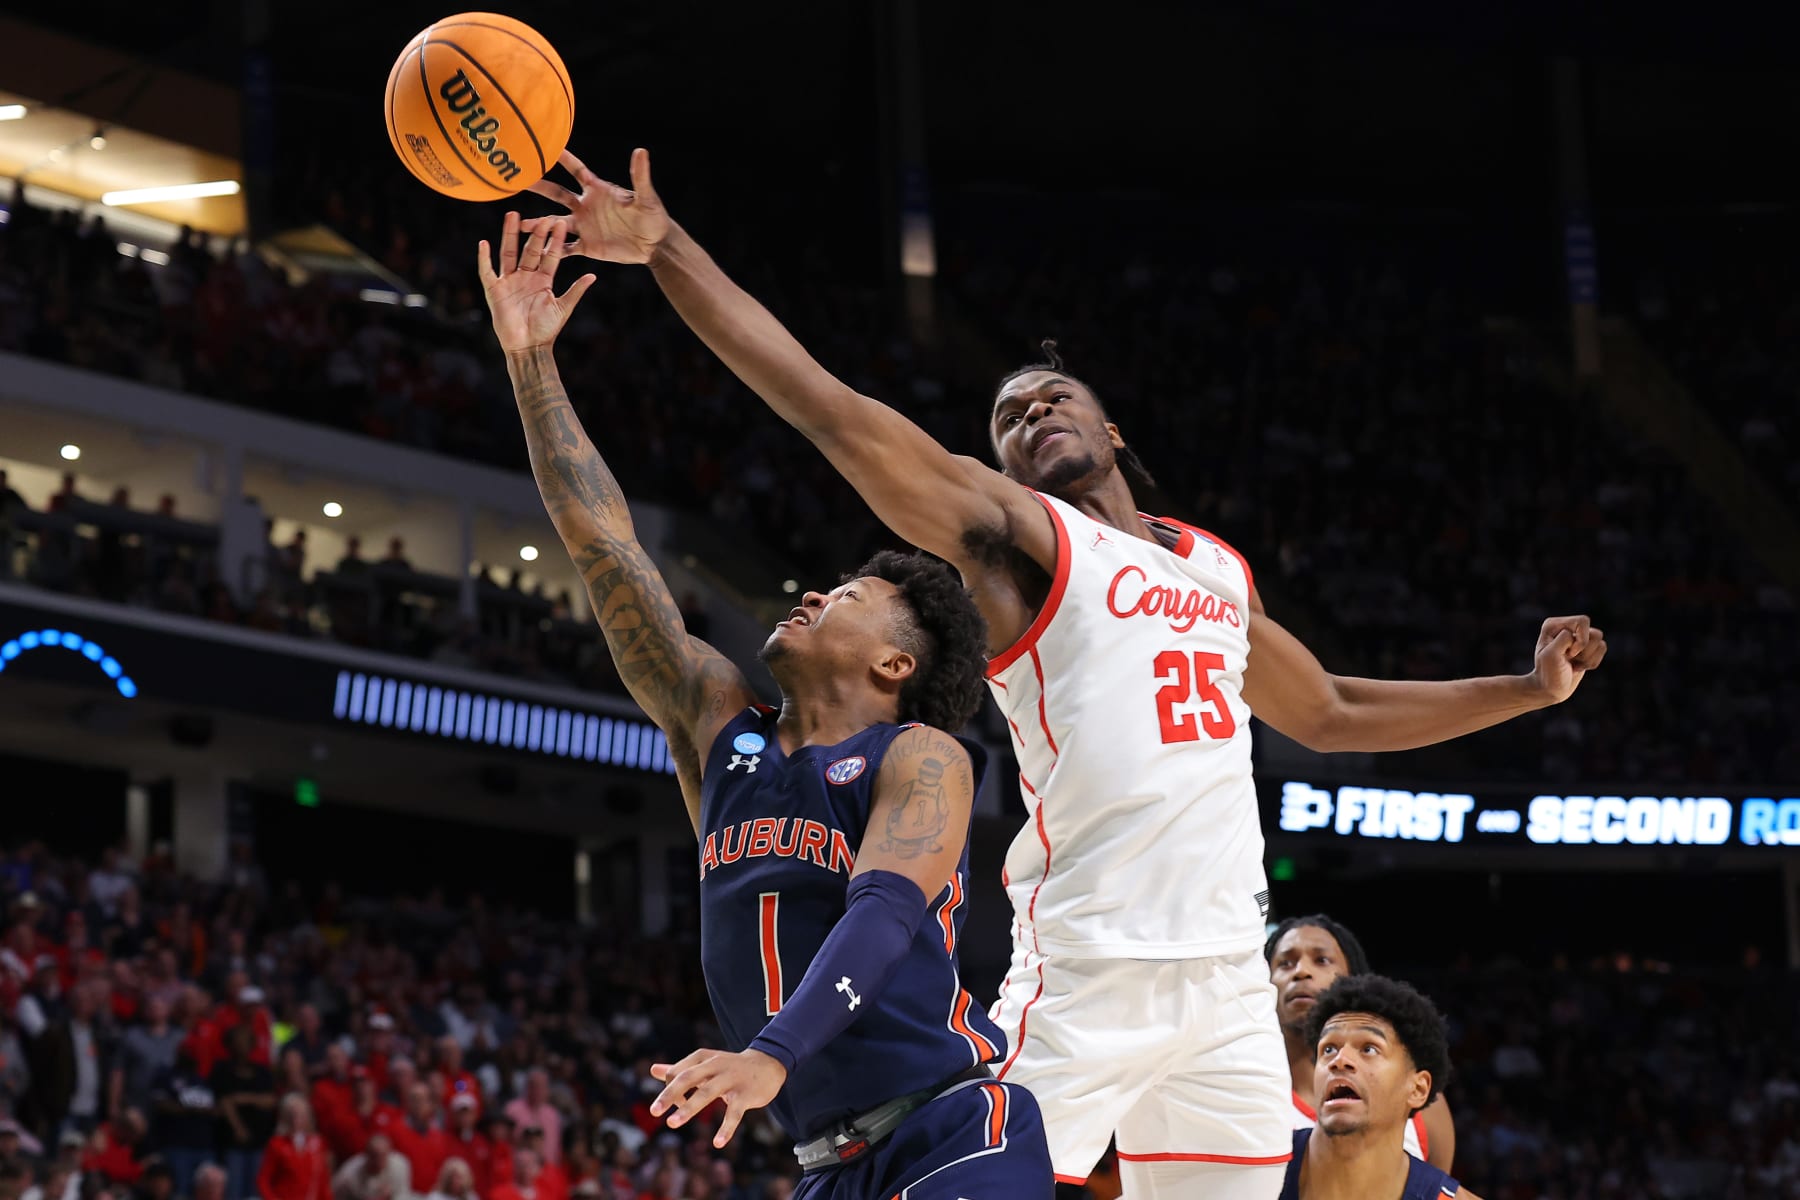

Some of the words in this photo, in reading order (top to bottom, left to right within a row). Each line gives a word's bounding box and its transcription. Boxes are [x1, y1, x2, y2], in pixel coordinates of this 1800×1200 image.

[441, 68, 522, 182] Wilson
[1107, 565, 1241, 633] Cougars
[1153, 650, 1236, 744] 25
[829, 757, 862, 782] SEC
[700, 818, 855, 881] AUBURN
[1334, 786, 1475, 843] FIRST
[1526, 795, 1733, 845] SECOND
[758, 892, 784, 1017] 1
